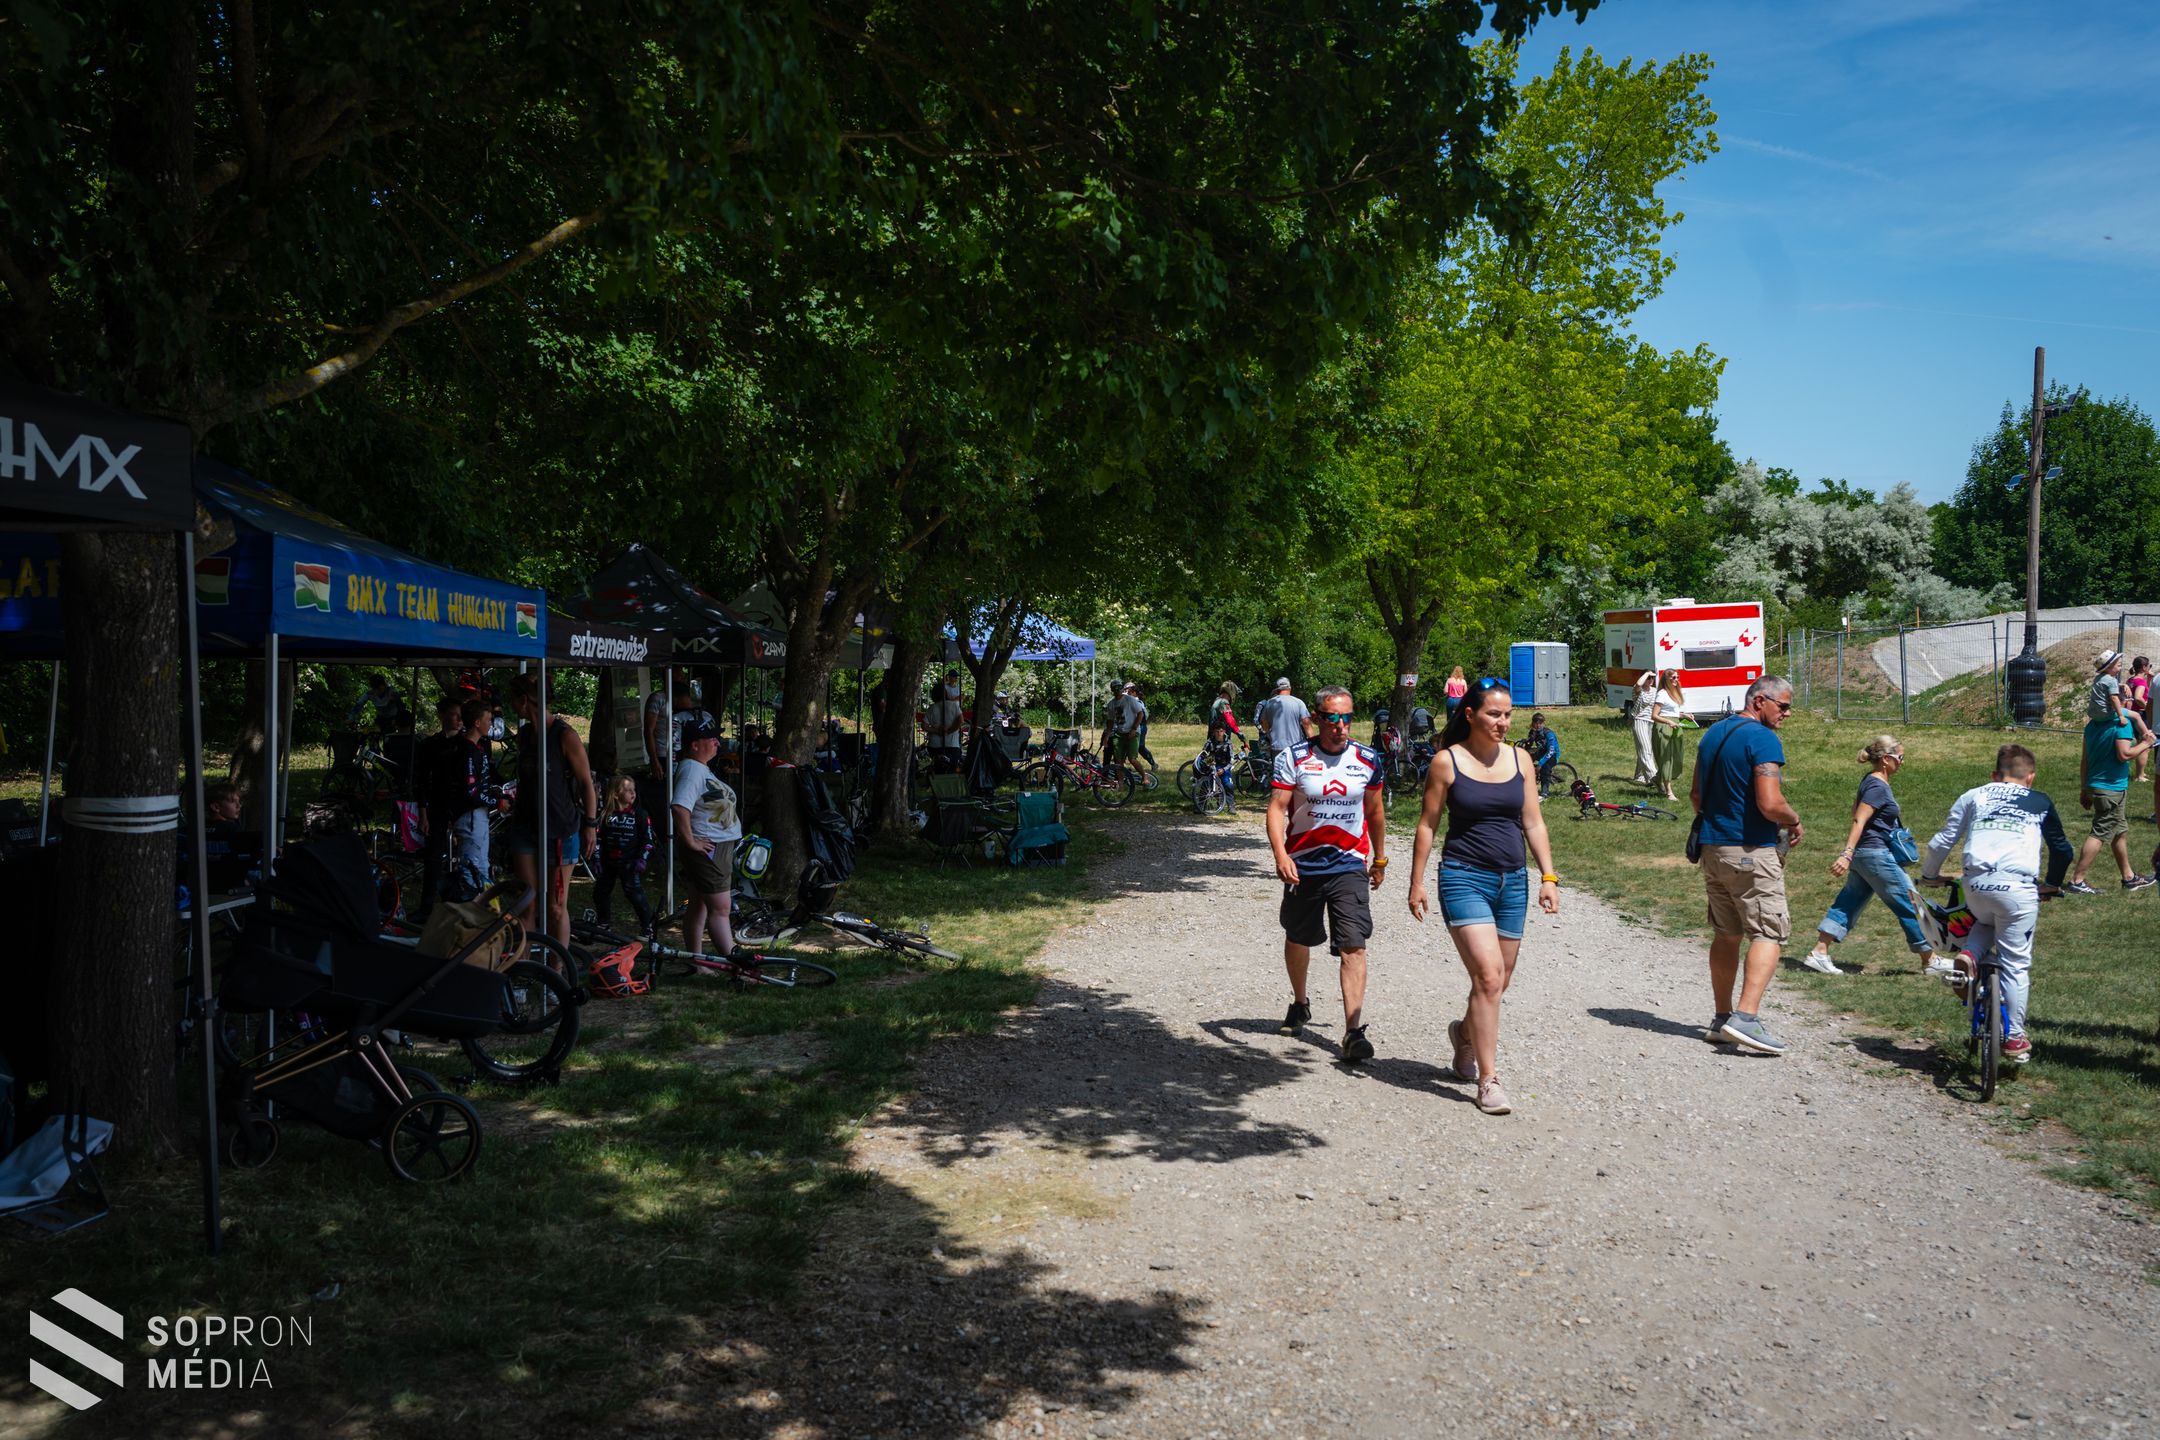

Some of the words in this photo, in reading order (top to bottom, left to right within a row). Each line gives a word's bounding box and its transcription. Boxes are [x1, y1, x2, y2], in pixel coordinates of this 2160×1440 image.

[346, 573, 388, 616] BMX
[396, 582, 440, 622] TEAM
[448, 591, 507, 632] HUNGARY
[570, 630, 648, 662] extremevital
[1307, 797, 1356, 806] Worthouse
[1307, 811, 1355, 820] FALKEN
[1972, 820, 2025, 834] BOCK
[1979, 884, 2011, 892] LEAD
